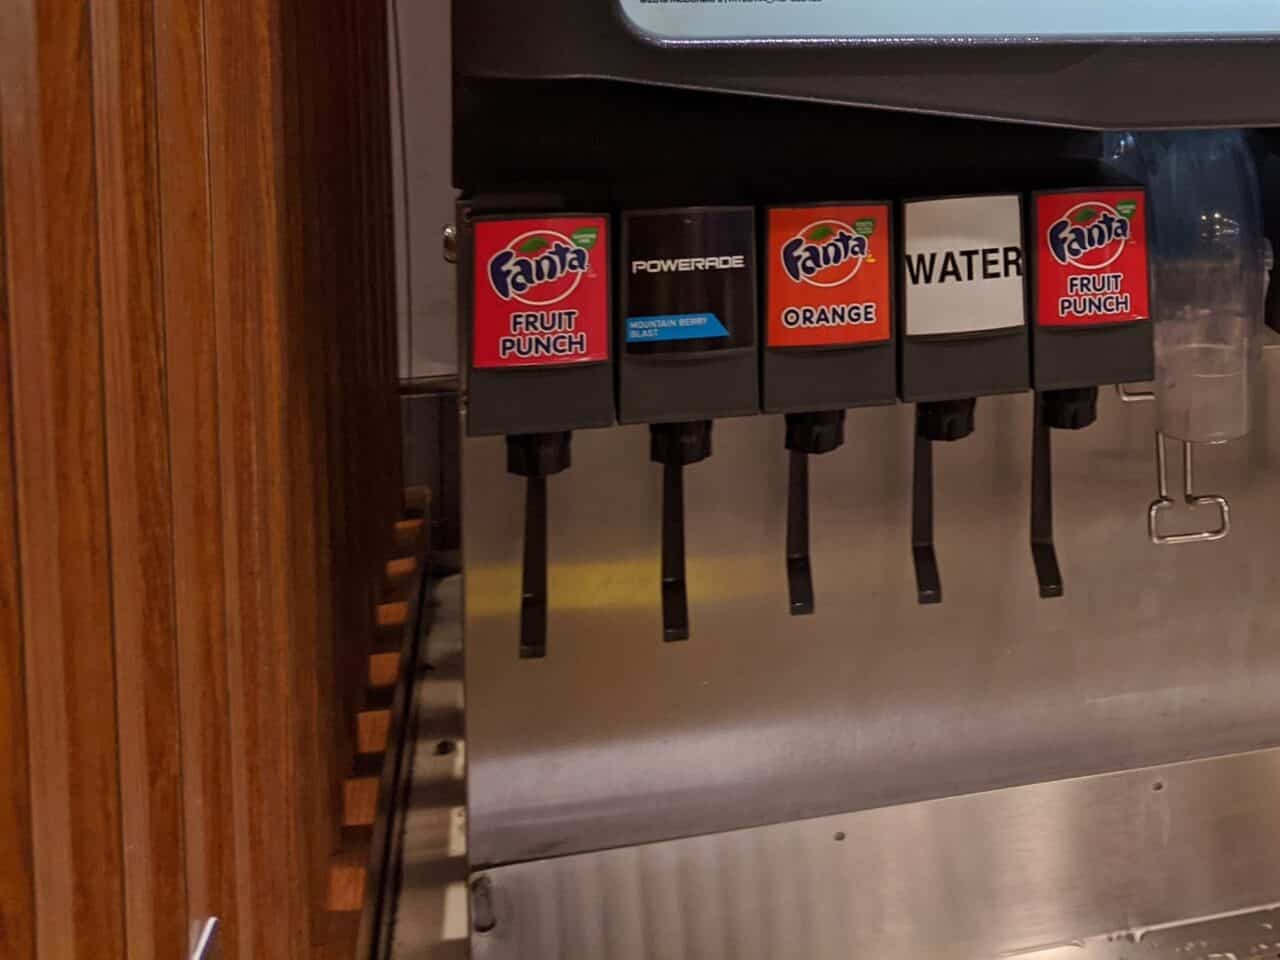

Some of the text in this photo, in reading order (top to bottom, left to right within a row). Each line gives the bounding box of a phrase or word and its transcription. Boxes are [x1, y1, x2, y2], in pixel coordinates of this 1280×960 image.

[1047, 210, 1130, 265] Fanta
[631, 255, 745, 275] POWERADE
[780, 230, 868, 283] Fanta
[904, 246, 1024, 285] WATER
[488, 241, 590, 301] Fanta
[1067, 272, 1124, 296] FRUIT
[782, 302, 877, 329] ORANGE
[1058, 293, 1130, 318] PUNCH
[511, 309, 578, 335] FRUIT
[629, 317, 708, 329] MOUNTAIN BERRY
[630, 329, 659, 338] BLAST
[501, 333, 586, 360] PUNCH
